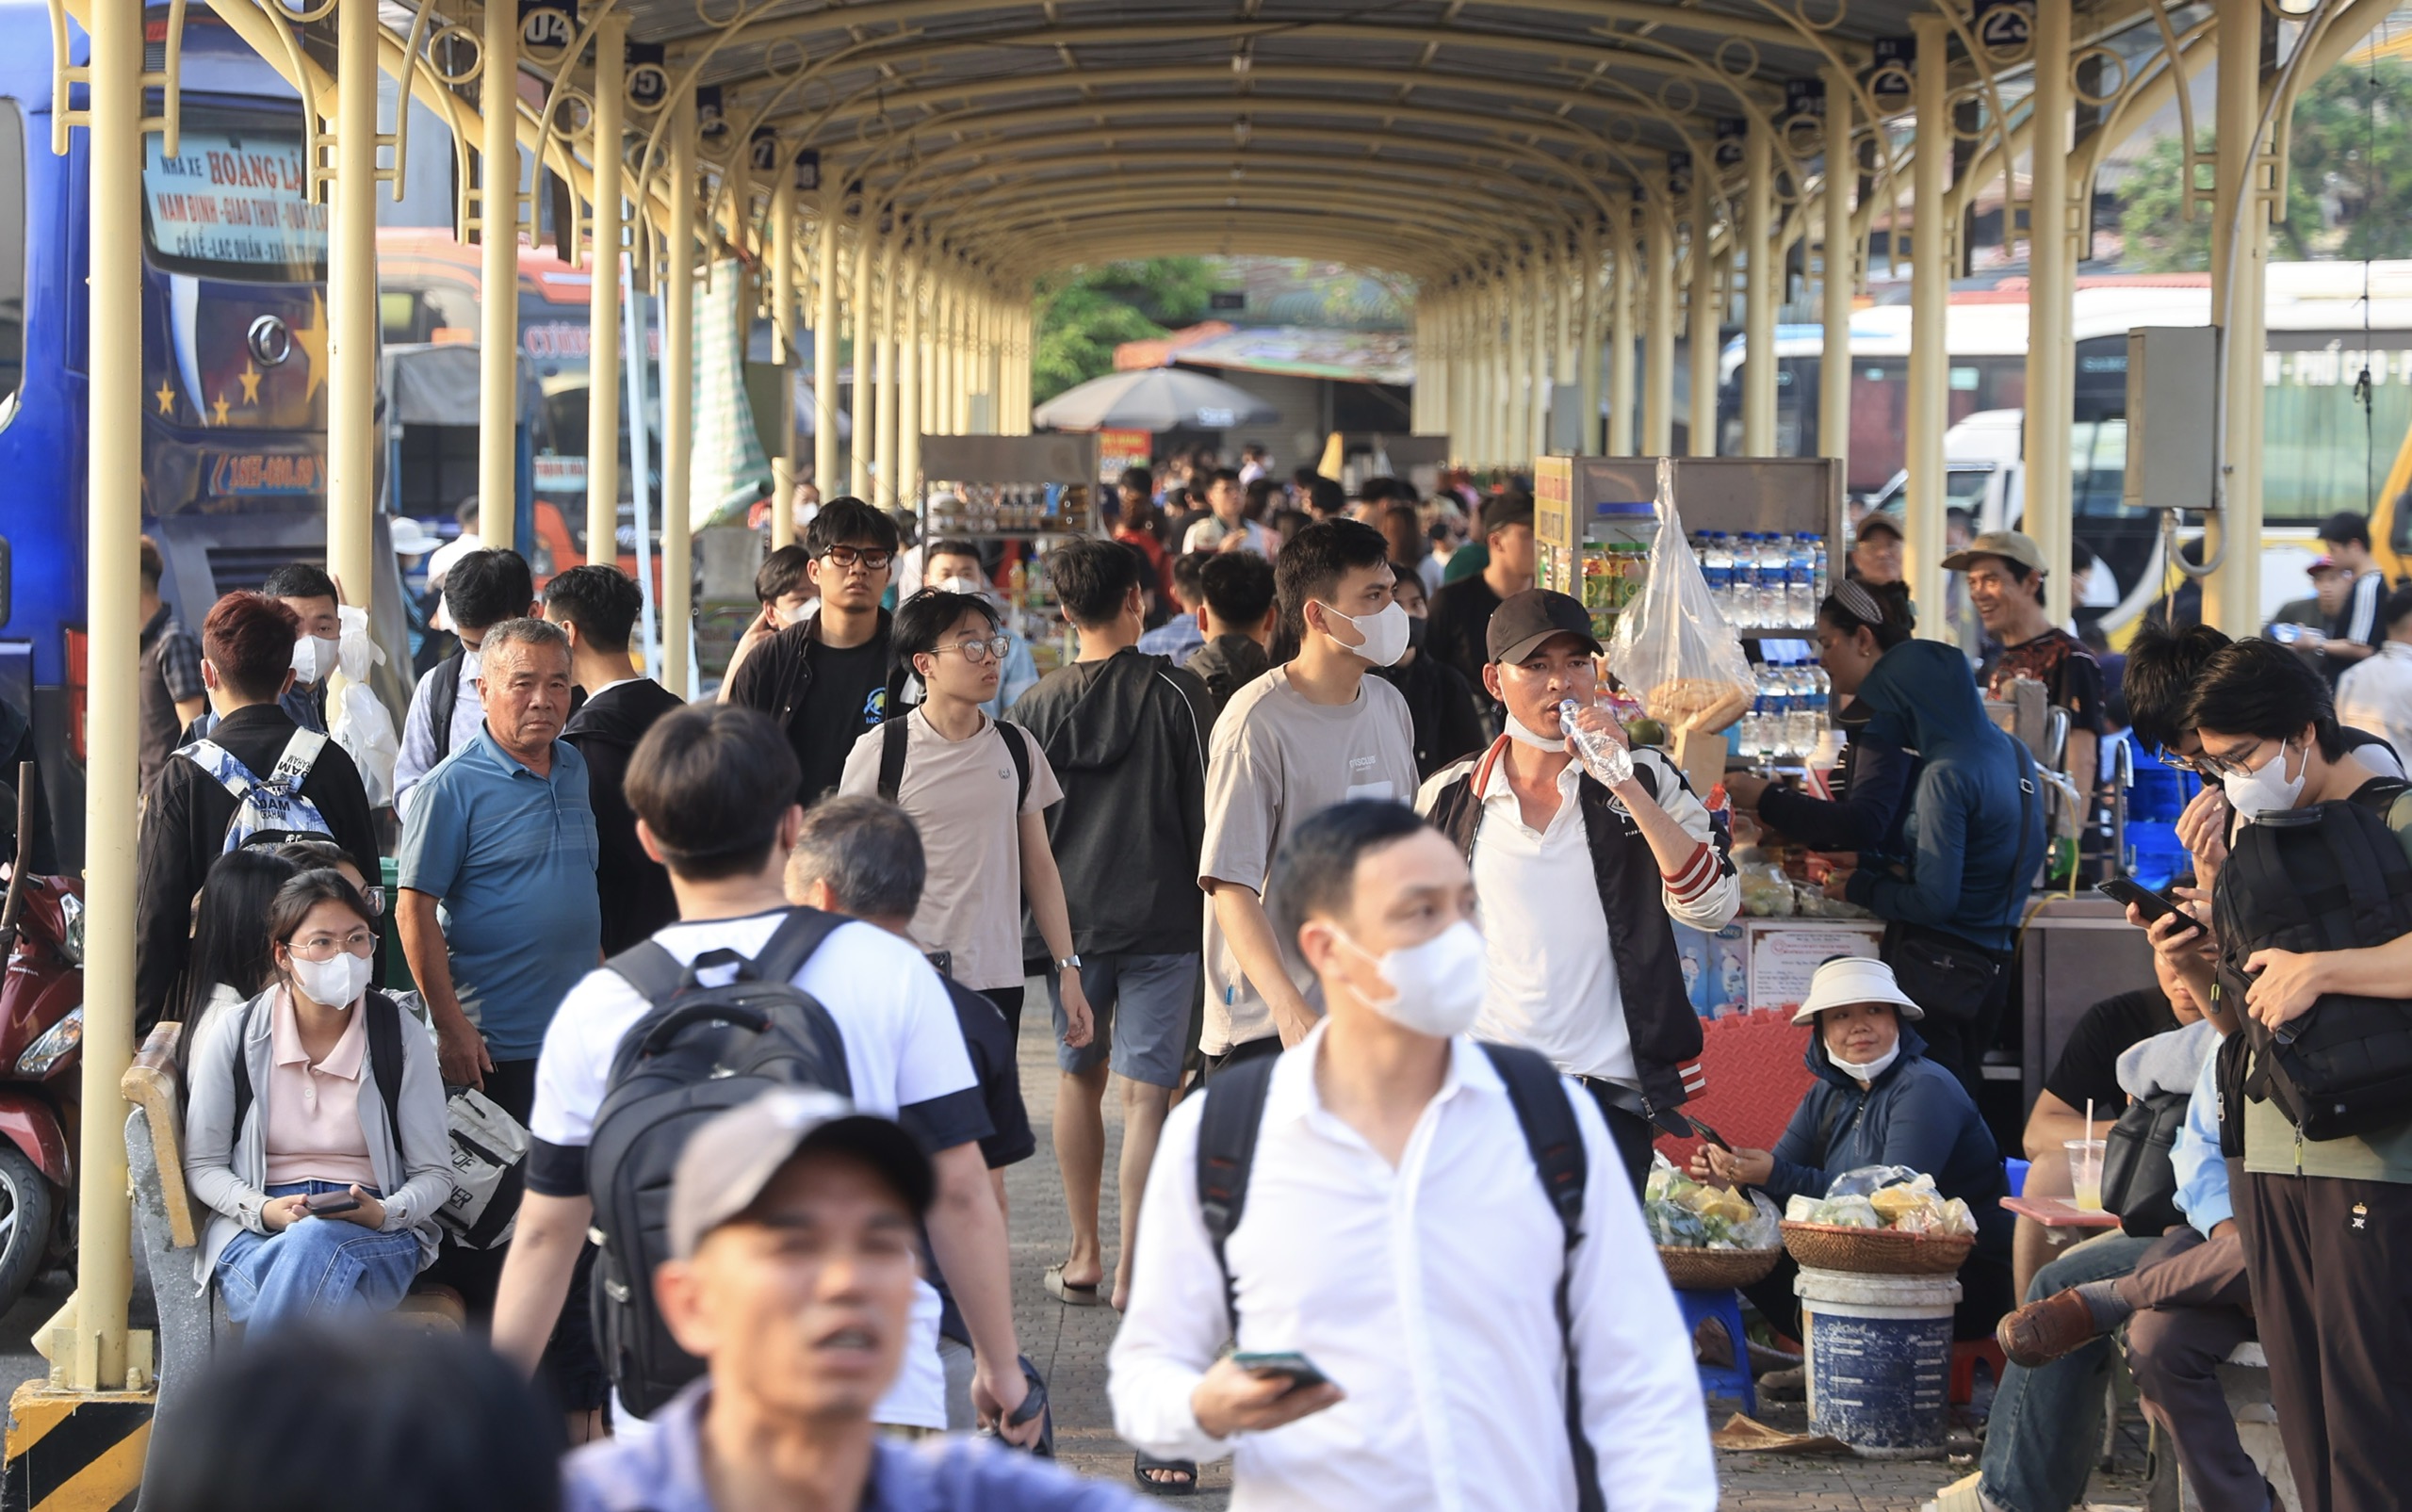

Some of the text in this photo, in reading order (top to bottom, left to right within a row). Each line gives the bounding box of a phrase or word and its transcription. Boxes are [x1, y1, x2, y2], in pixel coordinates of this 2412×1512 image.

[526, 8, 572, 43] 04
[187, 156, 204, 177] XE
[156, 192, 187, 222] NAM
